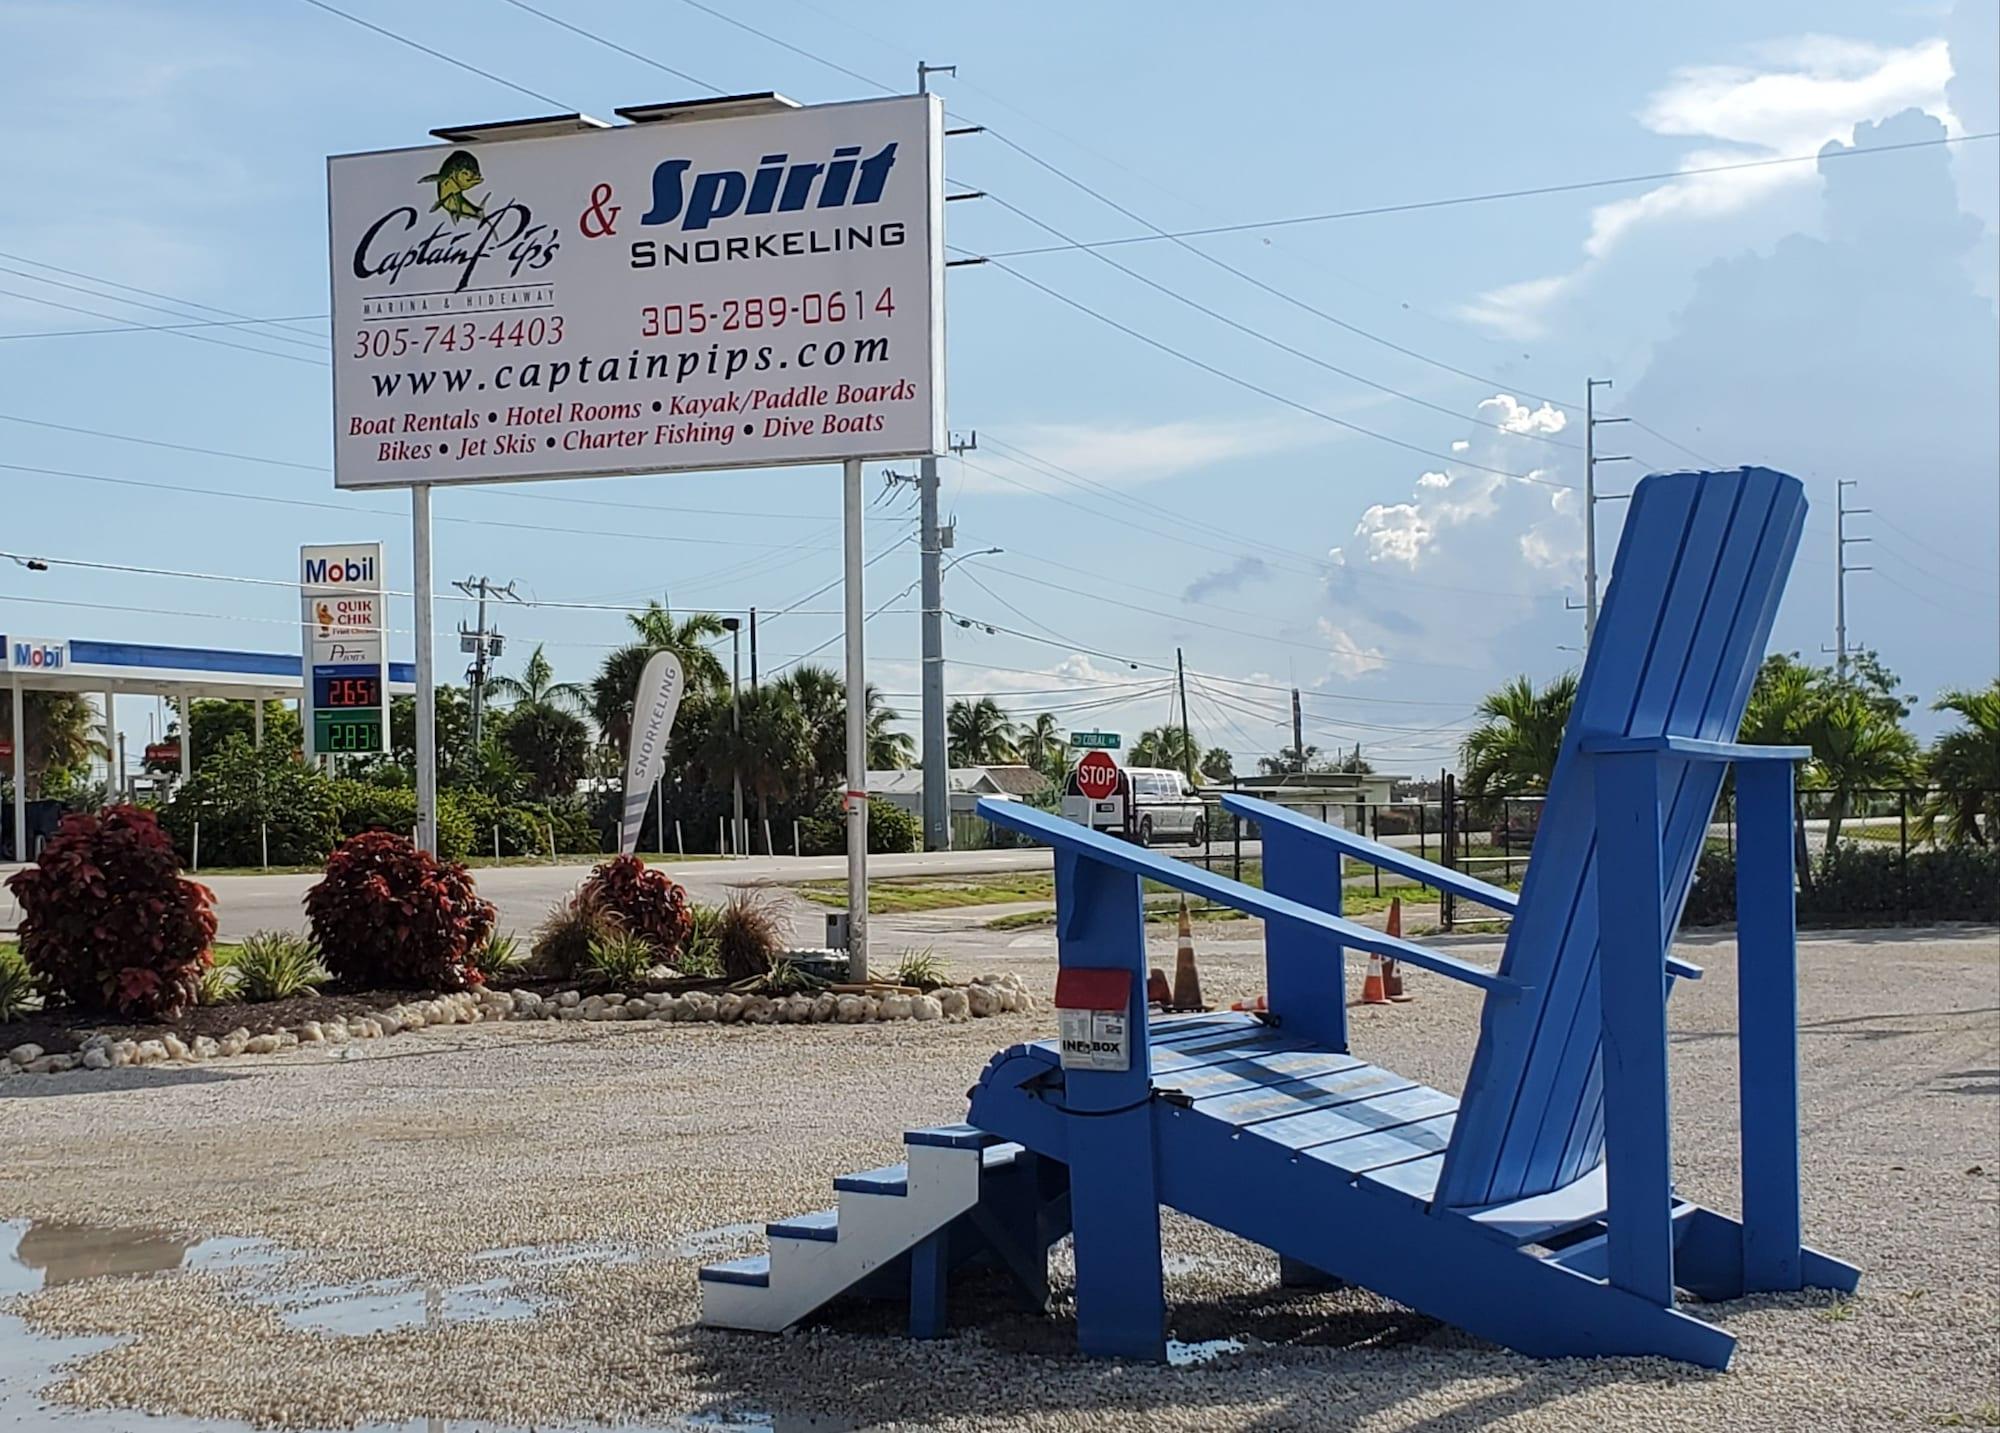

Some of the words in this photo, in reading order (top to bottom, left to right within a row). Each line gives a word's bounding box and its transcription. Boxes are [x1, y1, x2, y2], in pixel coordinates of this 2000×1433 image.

[640, 142, 899, 231] Spirit
[579, 183, 621, 238] &
[353, 206, 471, 285] Captain
[454, 199, 560, 293] Pip's
[631, 222, 905, 268] SNORKELING
[363, 300, 428, 314] MARINA
[443, 298, 450, 309] &
[467, 290, 554, 306] HIDEAWAY
[641, 287, 896, 337] 305-289-0614
[353, 316, 565, 359] 305-743-4403
[371, 336, 890, 397] www.captainpips.com
[349, 416, 396, 436] Boat
[402, 409, 480, 433] Rentals
[505, 403, 562, 427] Hotel
[569, 401, 642, 422] Rooms
[668, 385, 829, 418] Kayak/Paddle
[835, 379, 916, 405] Boards
[377, 441, 432, 461] Bikes
[456, 438, 486, 460] Jet
[493, 433, 536, 454] Skis
[562, 427, 648, 450] Charter
[654, 421, 735, 445] Fishing
[763, 417, 815, 438] Dive
[822, 413, 885, 434] Boats
[306, 557, 374, 583] Mobil
[337, 601, 372, 613] QUIK
[337, 614, 372, 625] CHIK
[14, 643, 64, 668] Mobil
[635, 666, 676, 779] SNORKELING
[1080, 766, 1115, 785] STOP
[1091, 1041, 1120, 1053] BOX
